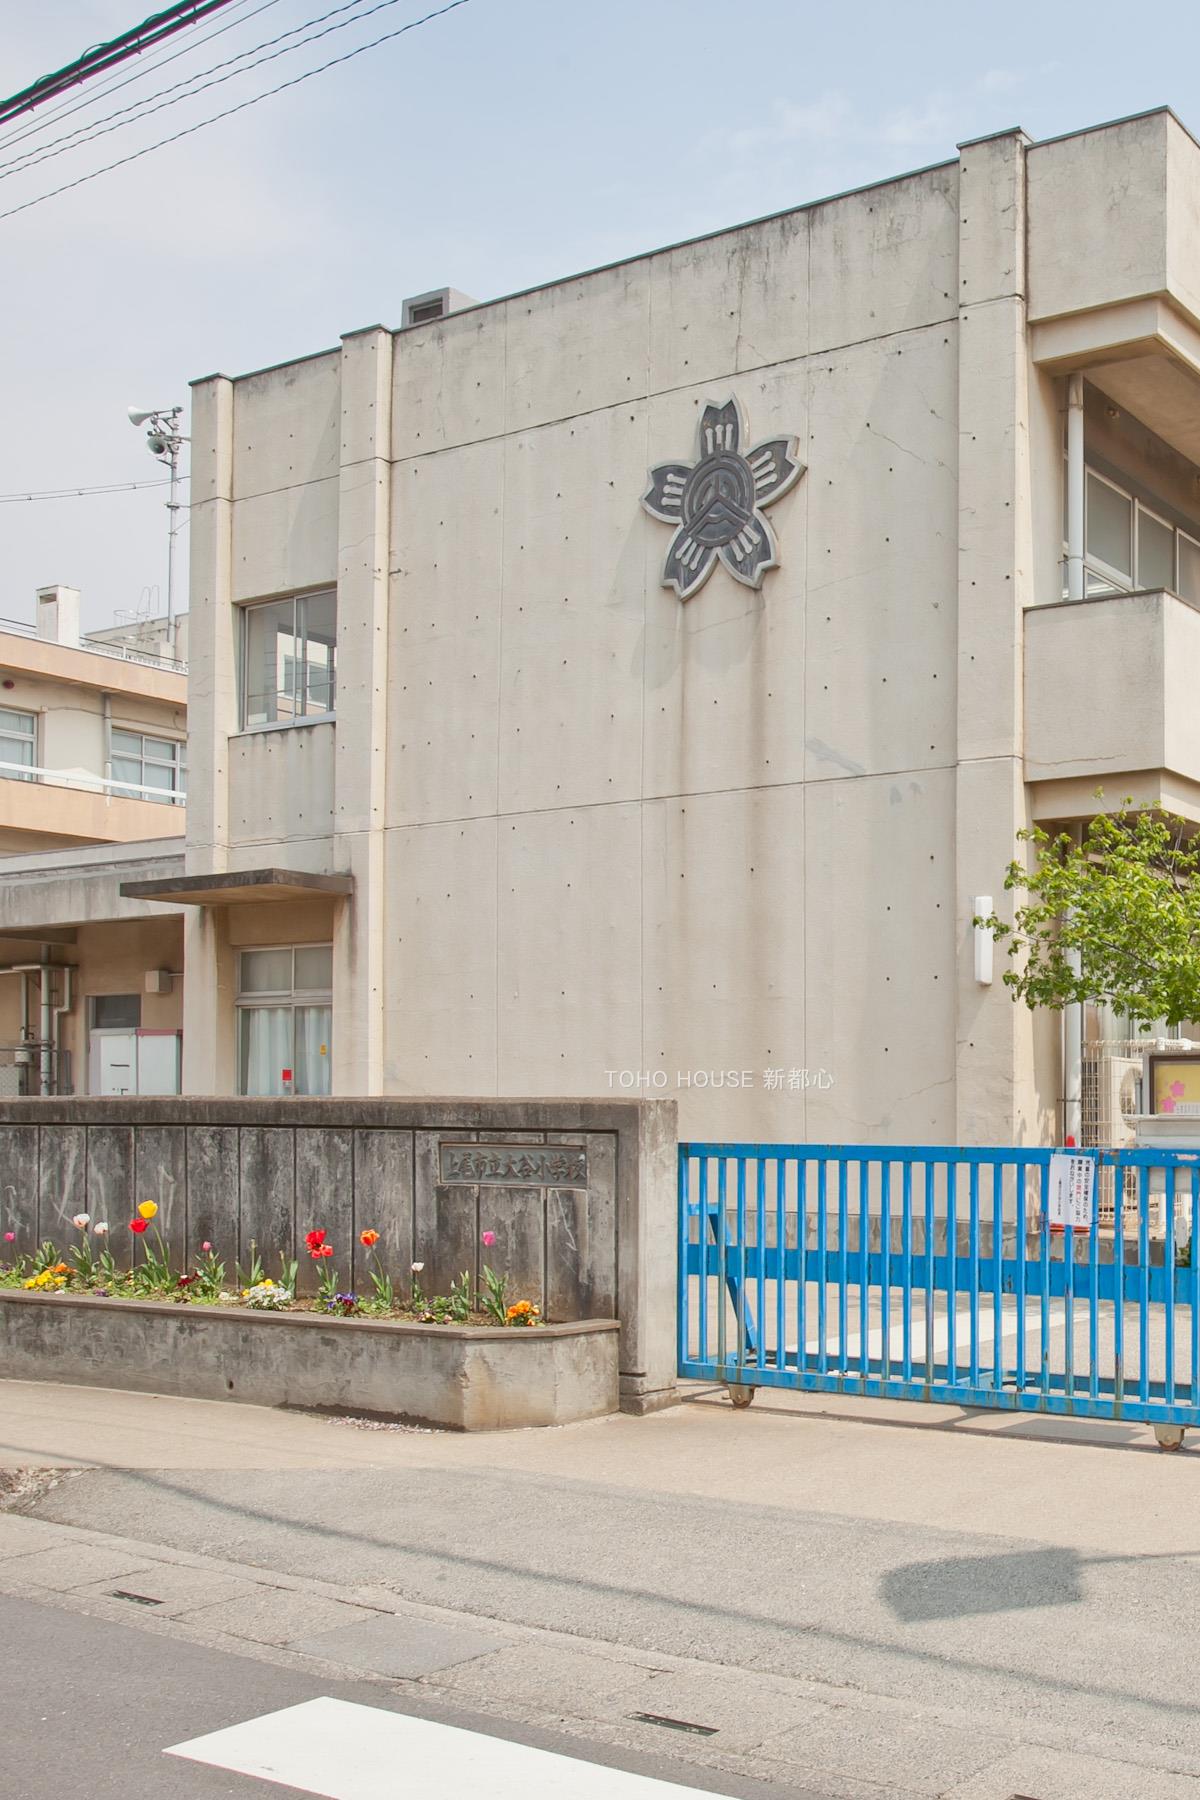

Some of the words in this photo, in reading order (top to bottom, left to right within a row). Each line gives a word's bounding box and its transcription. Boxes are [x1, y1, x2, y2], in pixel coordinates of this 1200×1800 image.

[447, 1151, 587, 1181] 上尾市立大谷小学校
